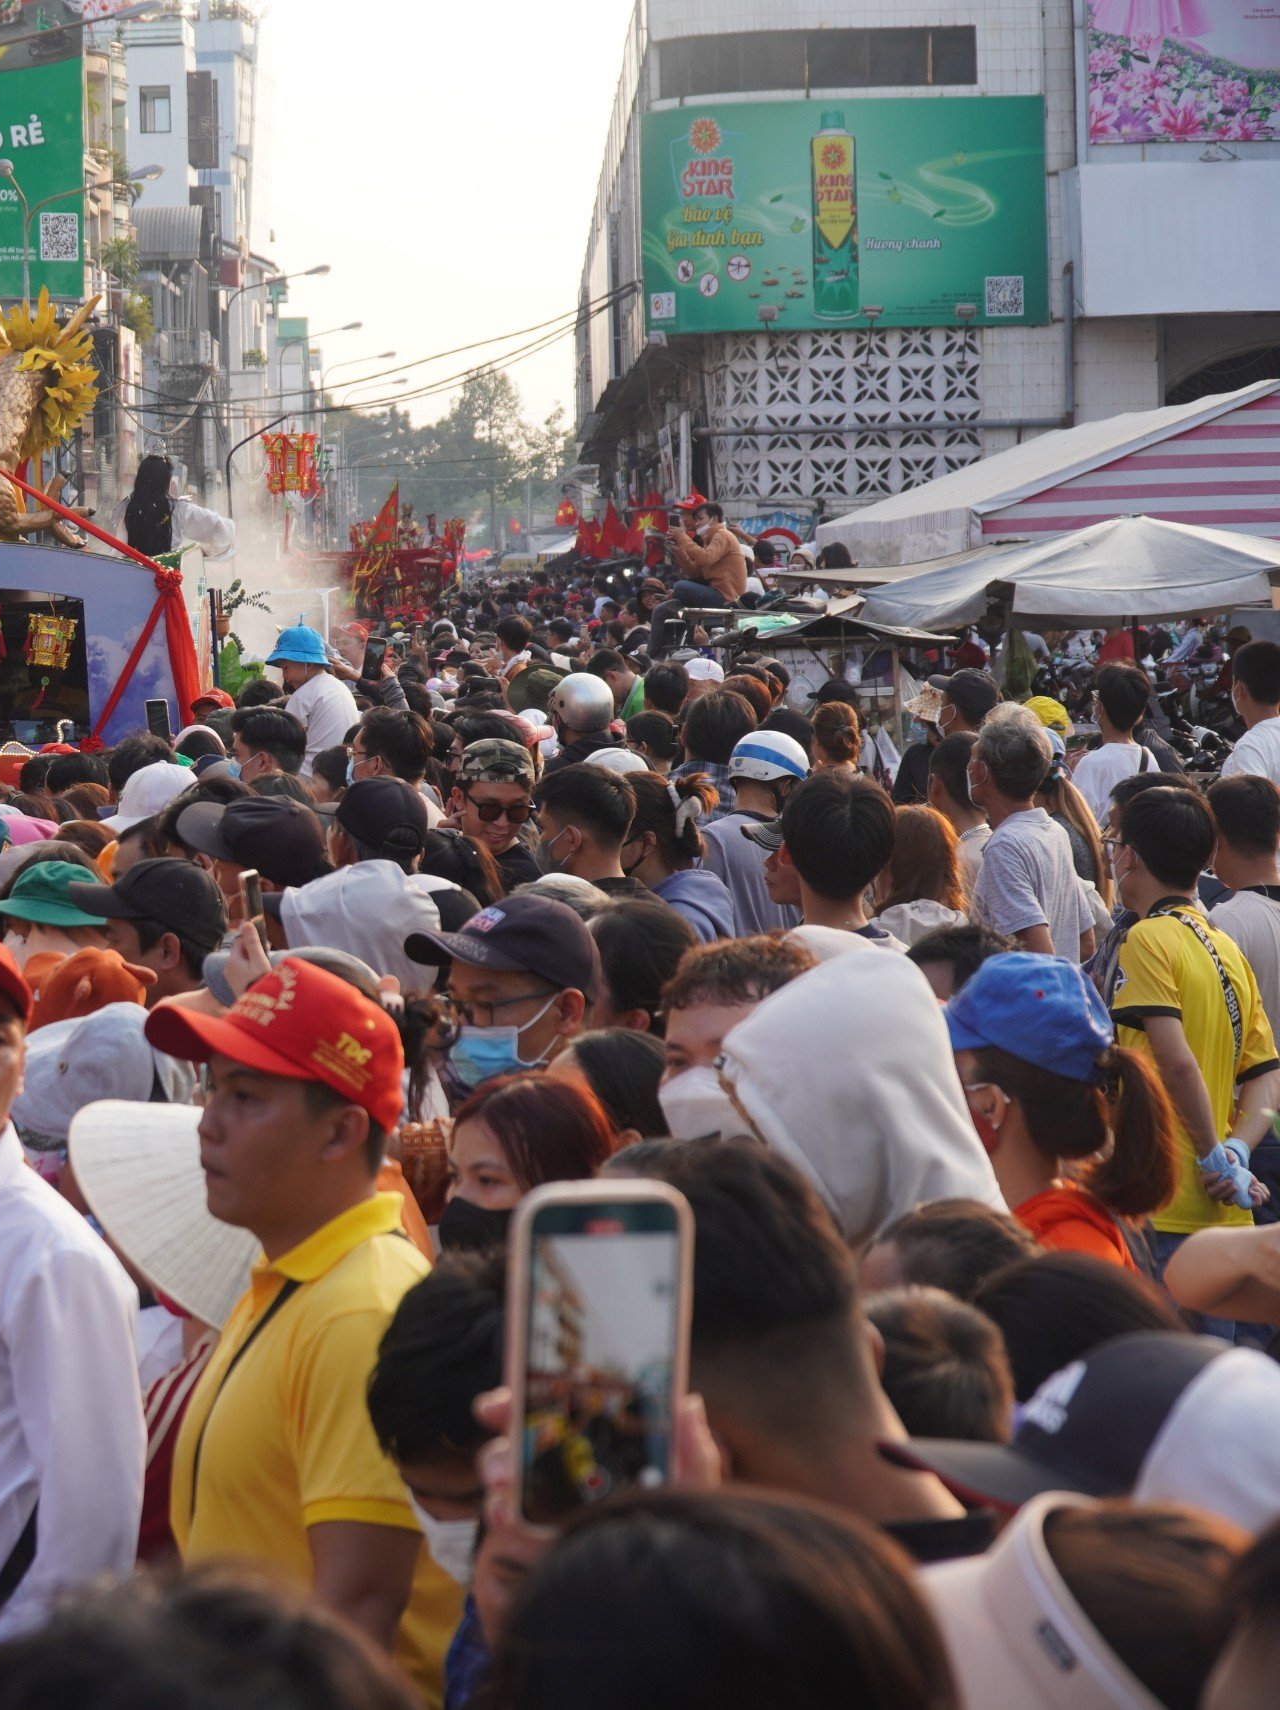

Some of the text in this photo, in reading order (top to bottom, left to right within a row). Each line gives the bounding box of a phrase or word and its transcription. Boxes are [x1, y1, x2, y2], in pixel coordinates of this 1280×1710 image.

[10, 114, 45, 149] RẺ
[687, 157, 734, 177] KING
[682, 168, 735, 199] STAR
[683, 203, 734, 225] Bảo vệ
[691, 228, 727, 248] đình
[731, 228, 765, 250] bạn
[866, 236, 942, 253] Hương chanh
[335, 1031, 373, 1065] TDC
